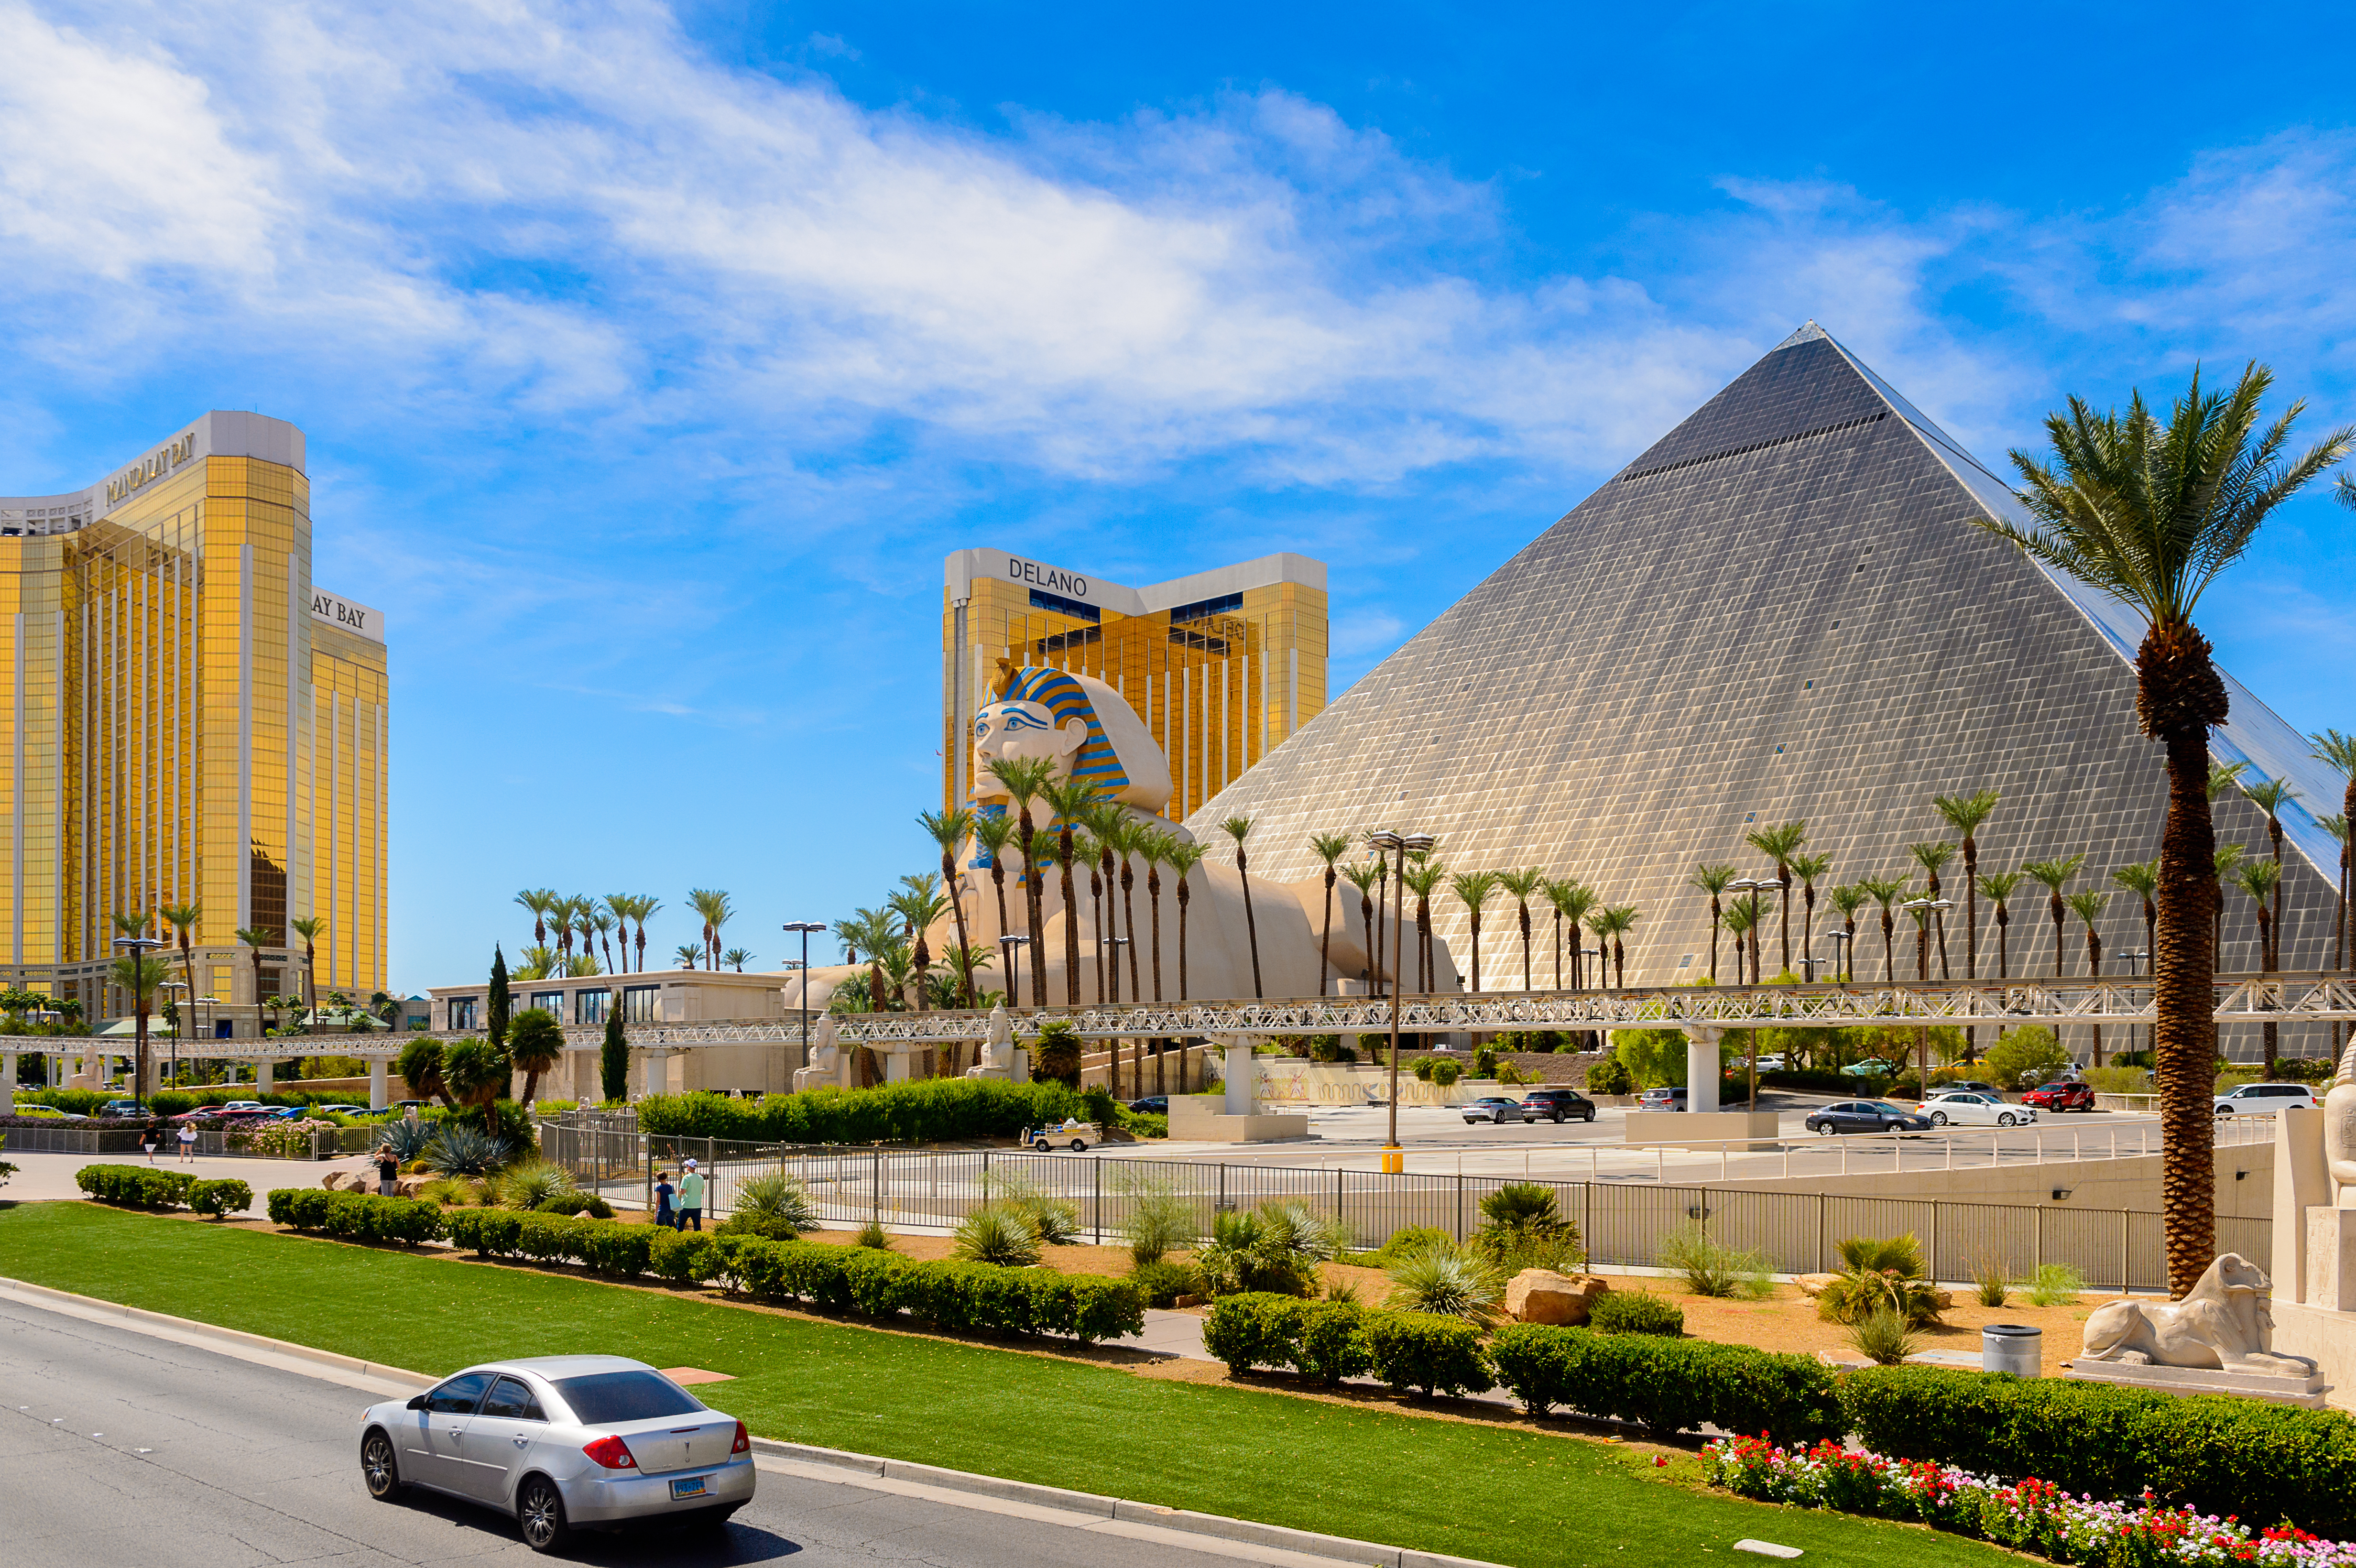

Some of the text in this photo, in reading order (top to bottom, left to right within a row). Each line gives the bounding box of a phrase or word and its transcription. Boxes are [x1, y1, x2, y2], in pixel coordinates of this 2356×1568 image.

[106, 433, 195, 507] MANDALAY BAY
[1010, 558, 1087, 596] DELANO
[337, 602, 366, 629] BAY
